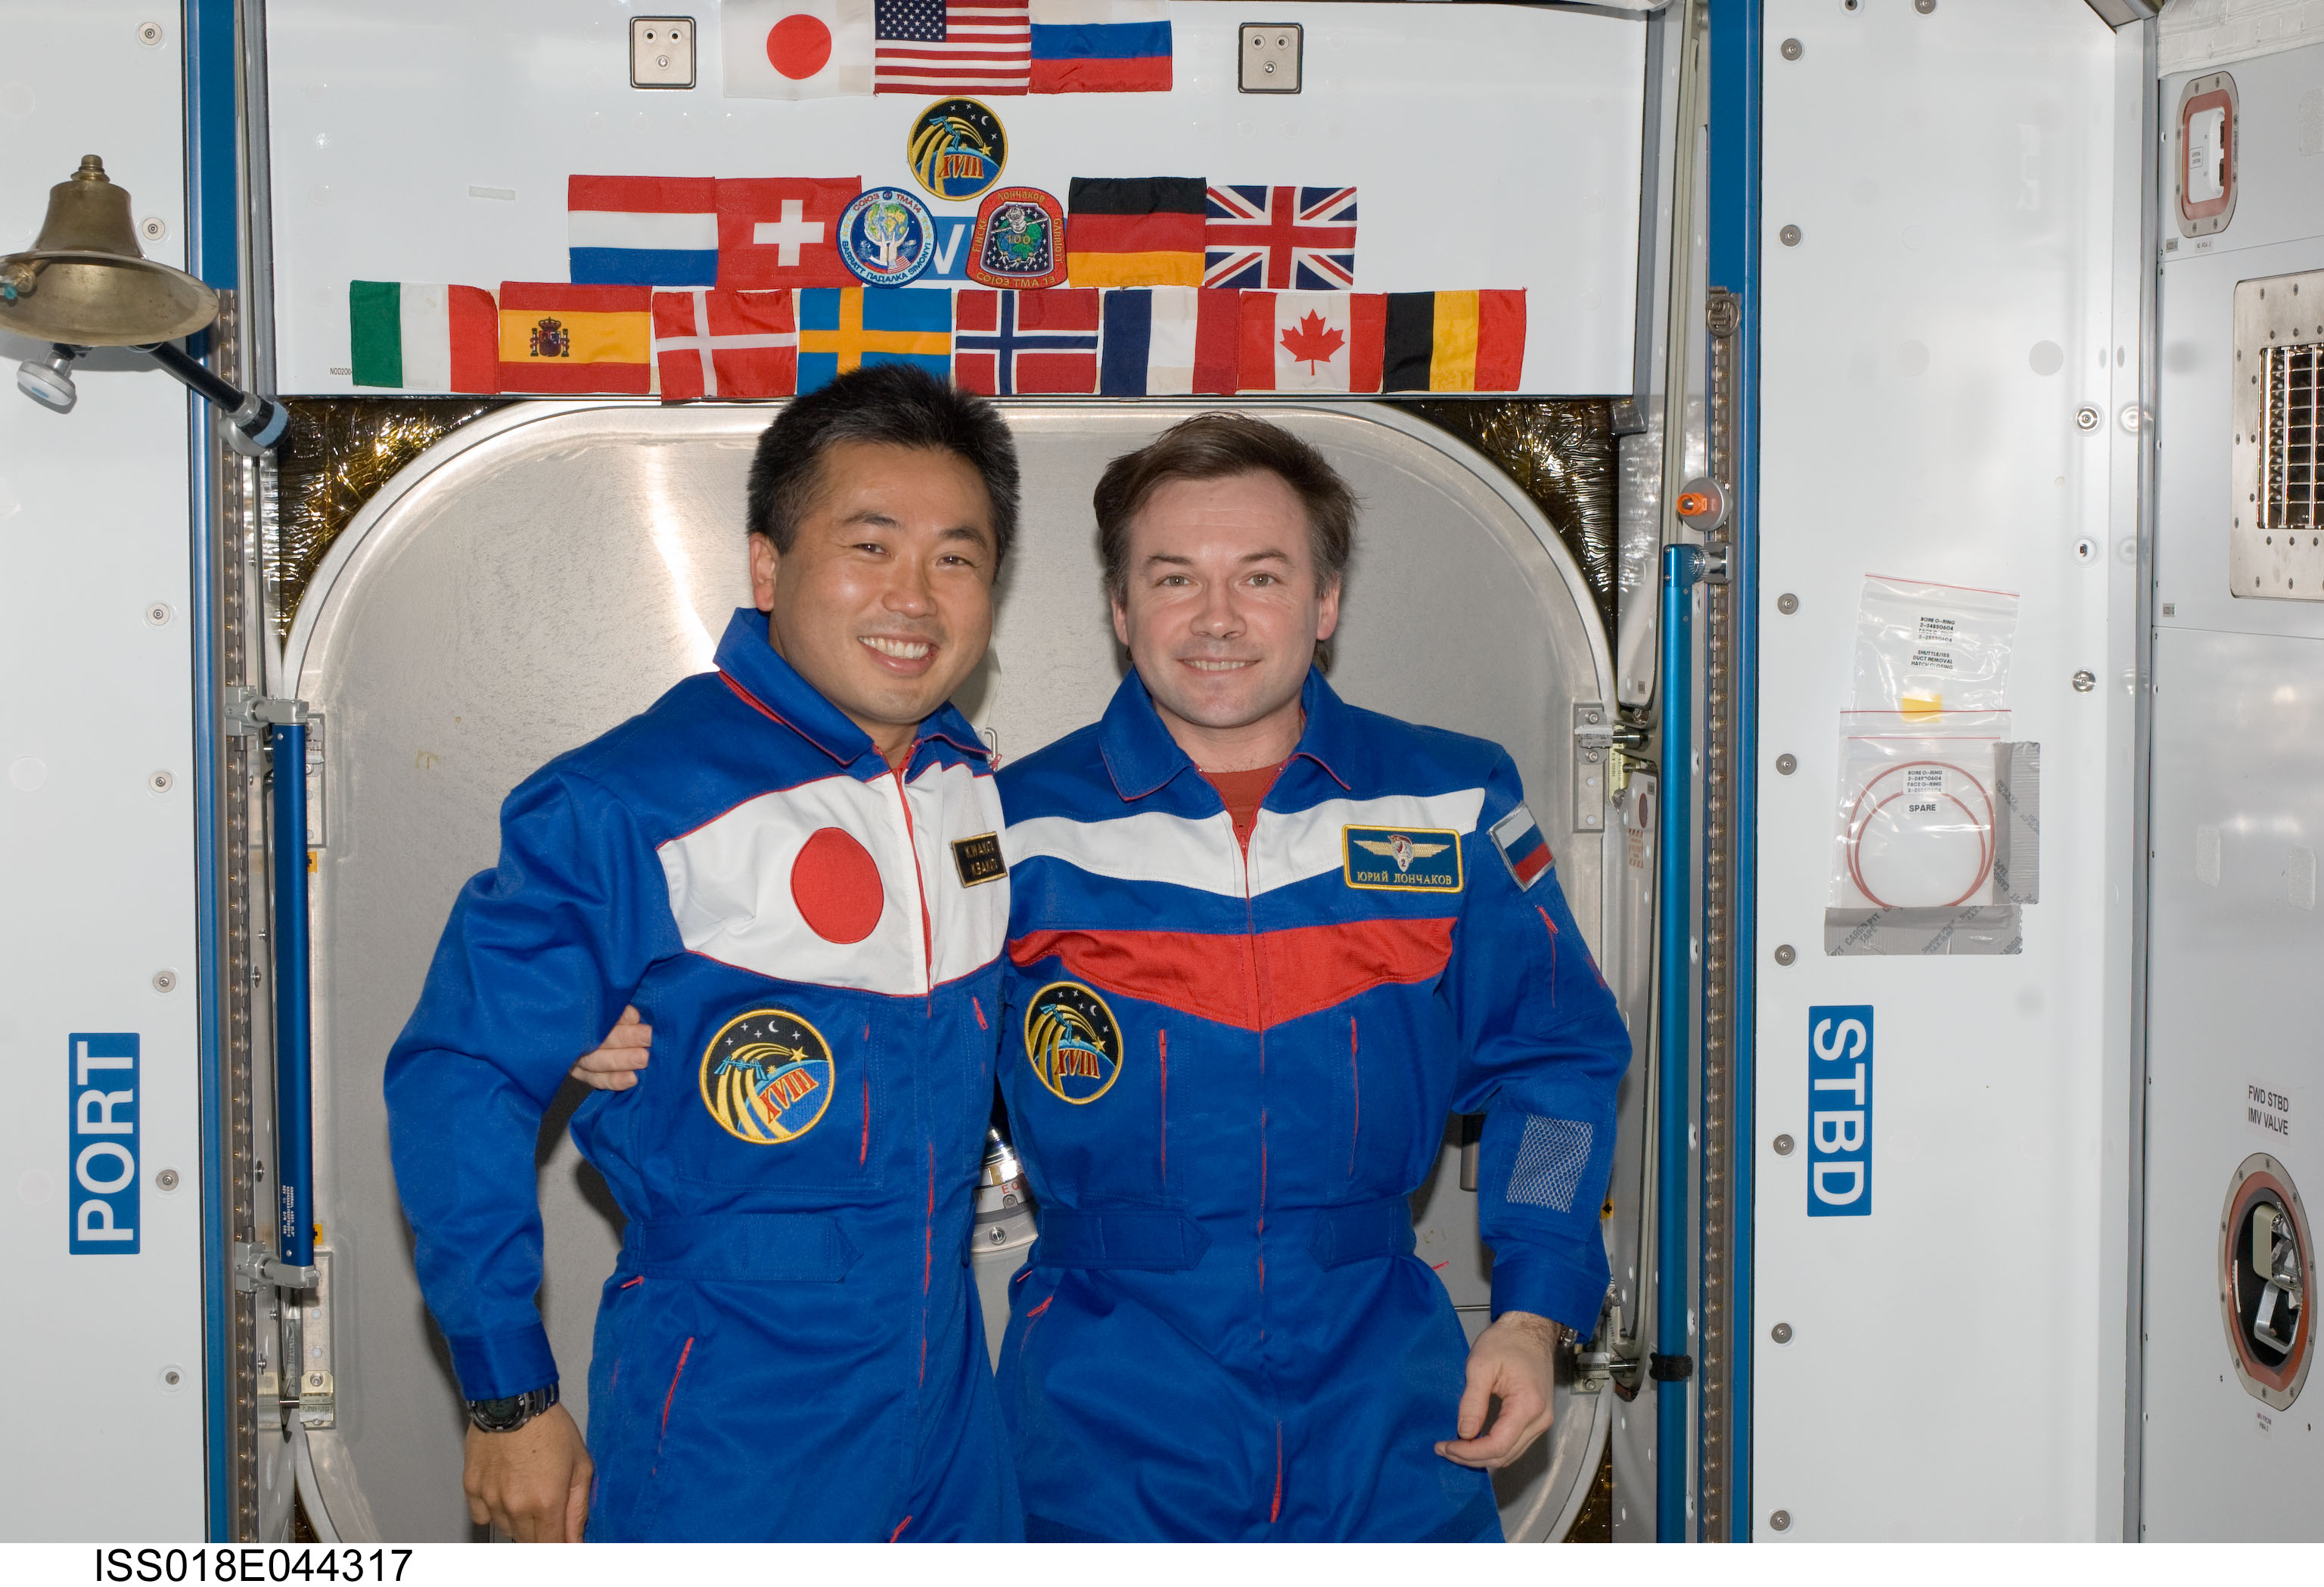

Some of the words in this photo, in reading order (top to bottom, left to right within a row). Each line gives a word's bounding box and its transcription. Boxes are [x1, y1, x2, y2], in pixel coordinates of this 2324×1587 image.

[938, 154, 984, 179] XVIII
[853, 193, 880, 211] СОЮЗ
[972, 218, 987, 253] FINCKE
[1007, 235, 1031, 244] 100
[1043, 275, 1056, 284] 13
[1918, 650, 1950, 658] SHUTTLE/ISS
[1909, 804, 1937, 812] SPARE
[1356, 871, 1389, 883] ЮРИЙ
[1393, 873, 1452, 885] ЛОНЧАКОВ
[1844, 922, 1868, 946] CARGO
[1866, 912, 1881, 925] PIT
[1053, 1049, 1101, 1079] XVIII
[759, 1067, 819, 1125] XVIII
[2248, 1085, 2266, 1104] FWD
[2267, 1092, 2289, 1113] STBD
[1813, 1018, 1867, 1206] STBD
[2248, 1107, 2262, 1126] IMV
[2263, 1112, 2288, 1136] VALVE
[76, 1041, 135, 1242] PORT
